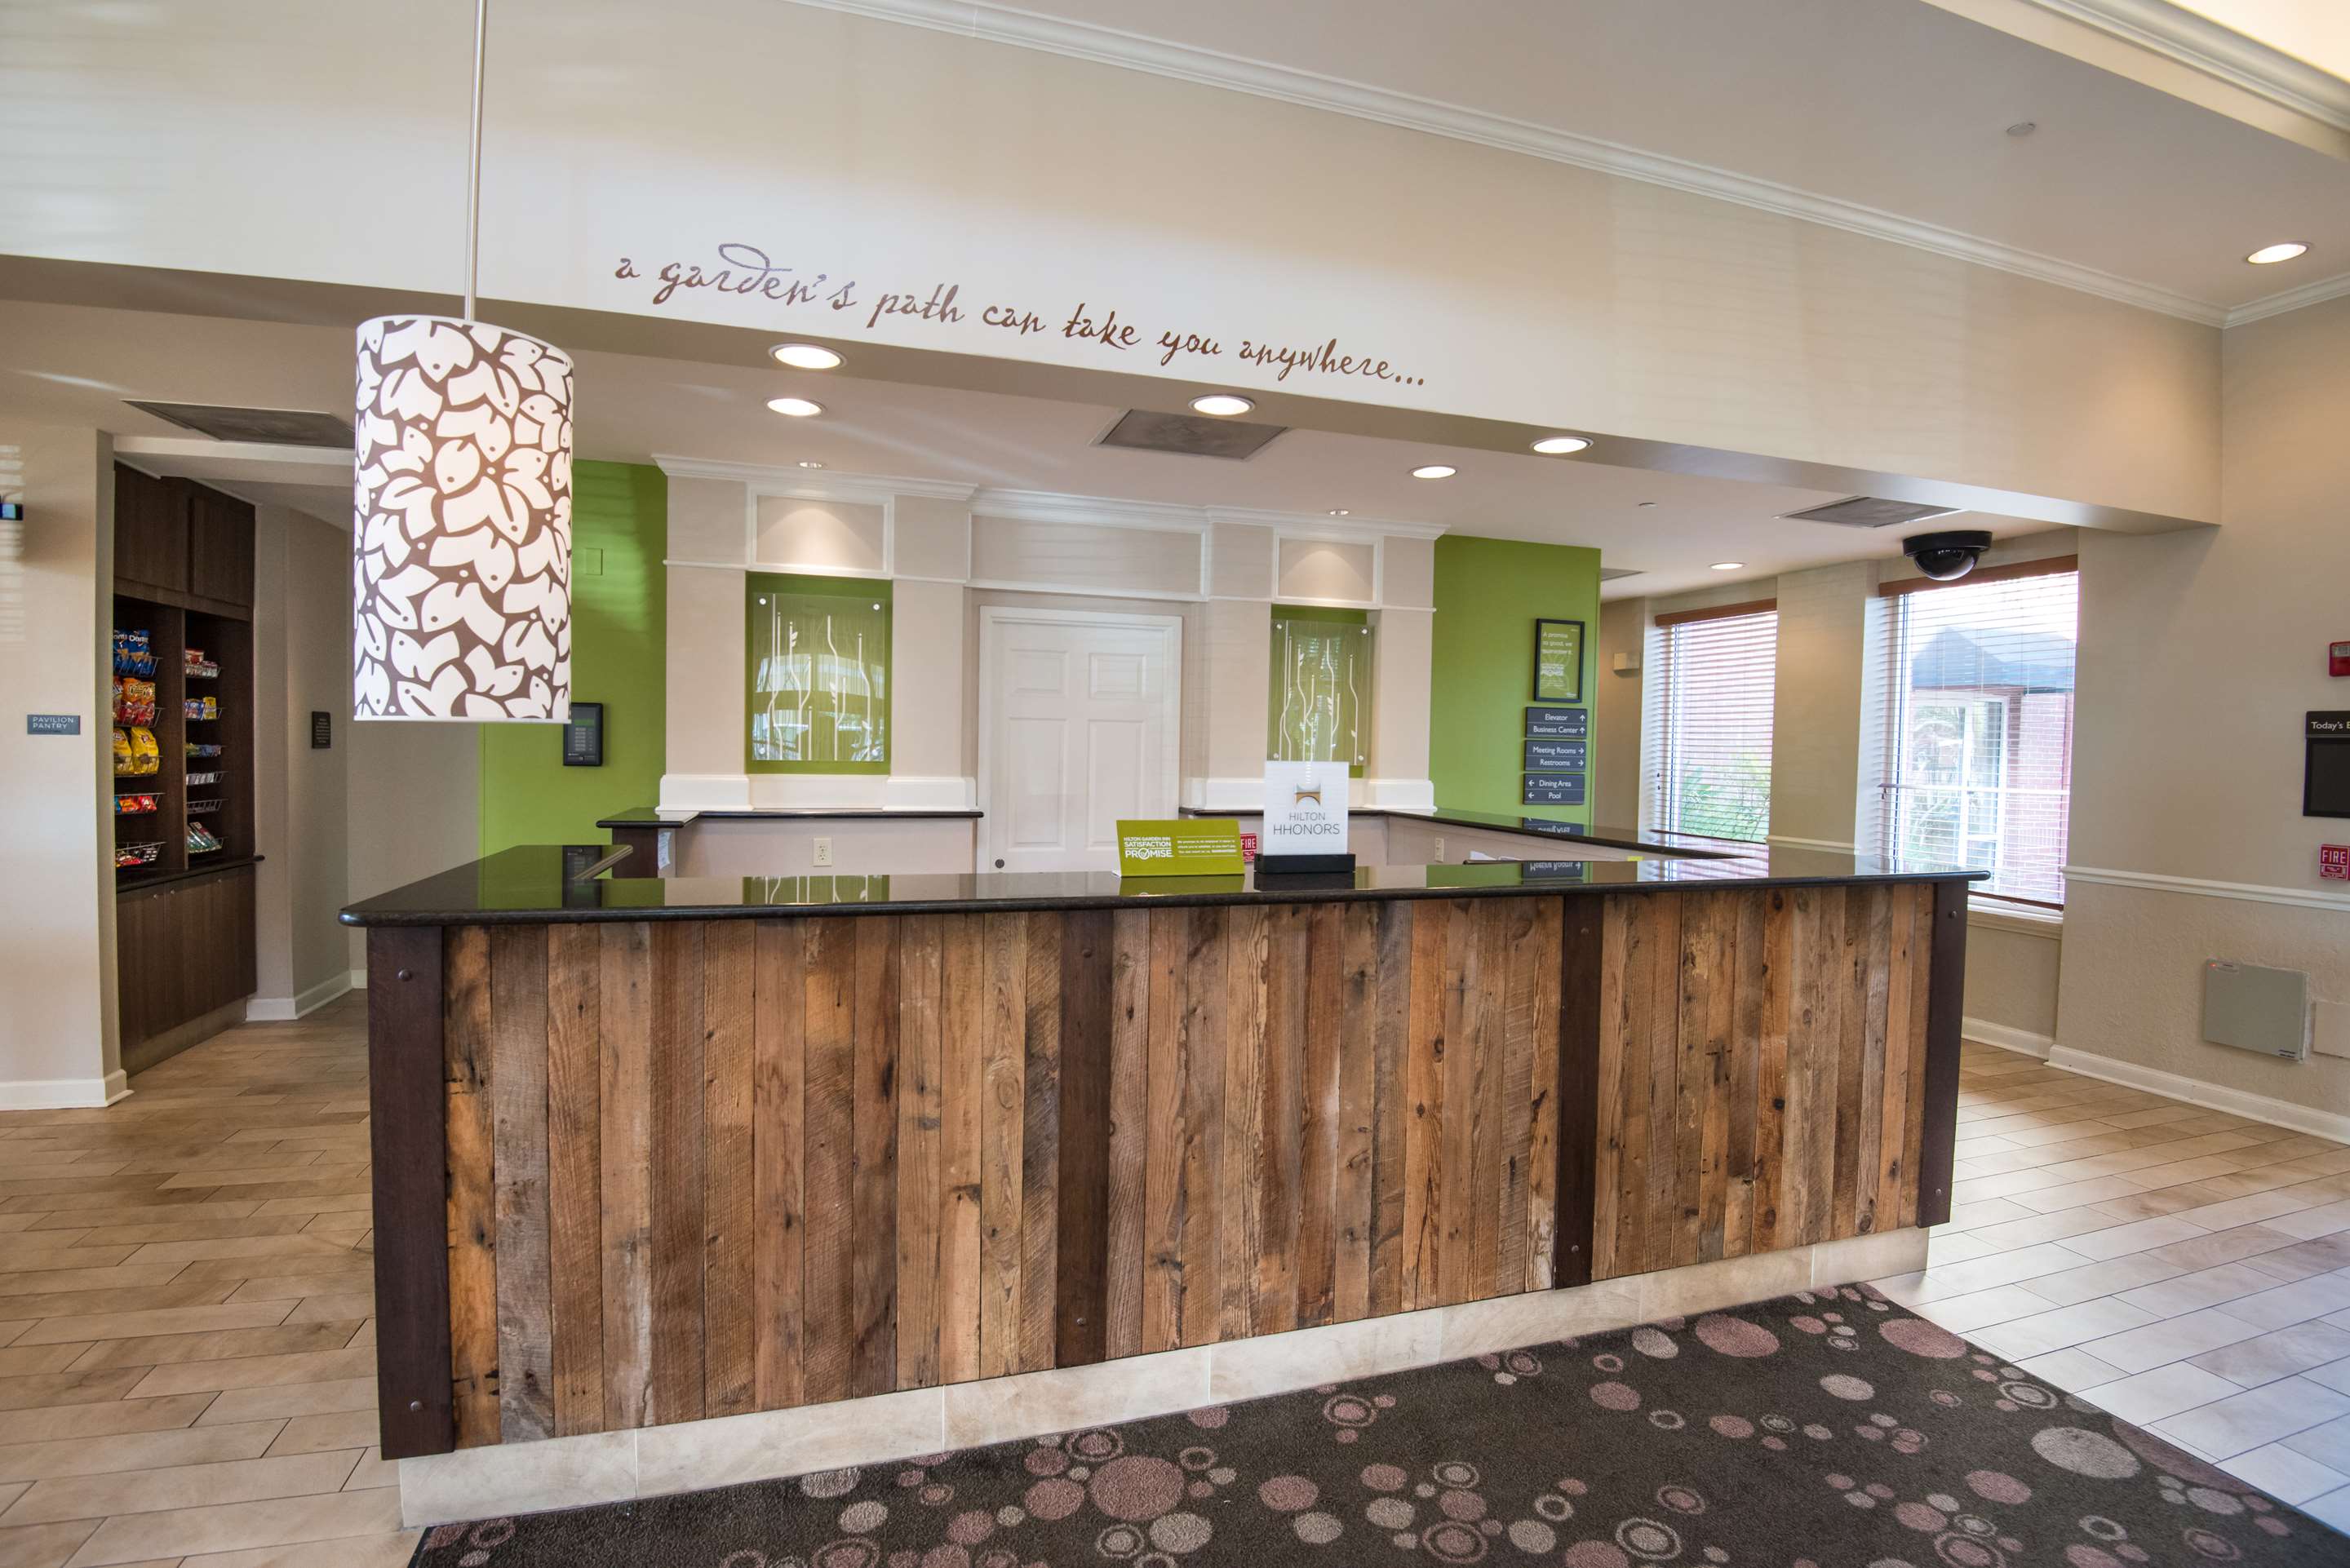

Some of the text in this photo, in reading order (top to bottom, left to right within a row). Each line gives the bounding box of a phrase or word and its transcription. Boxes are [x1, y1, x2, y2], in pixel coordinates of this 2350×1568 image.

[614, 243, 1425, 386] a garden's path can take you anywhere...
[1545, 713, 1568, 721] Elevator
[1533, 725, 1557, 733] Business
[2311, 721, 2343, 731] Today's
[1532, 746, 1556, 755] Meeting
[1540, 758, 1571, 766] Restrooms
[1539, 779, 1558, 789] Dining
[1288, 812, 1325, 821] HILTON
[1273, 823, 1340, 835] HHONORS
[1240, 839, 1256, 849] FIRE
[2322, 849, 2347, 864] FIRE
